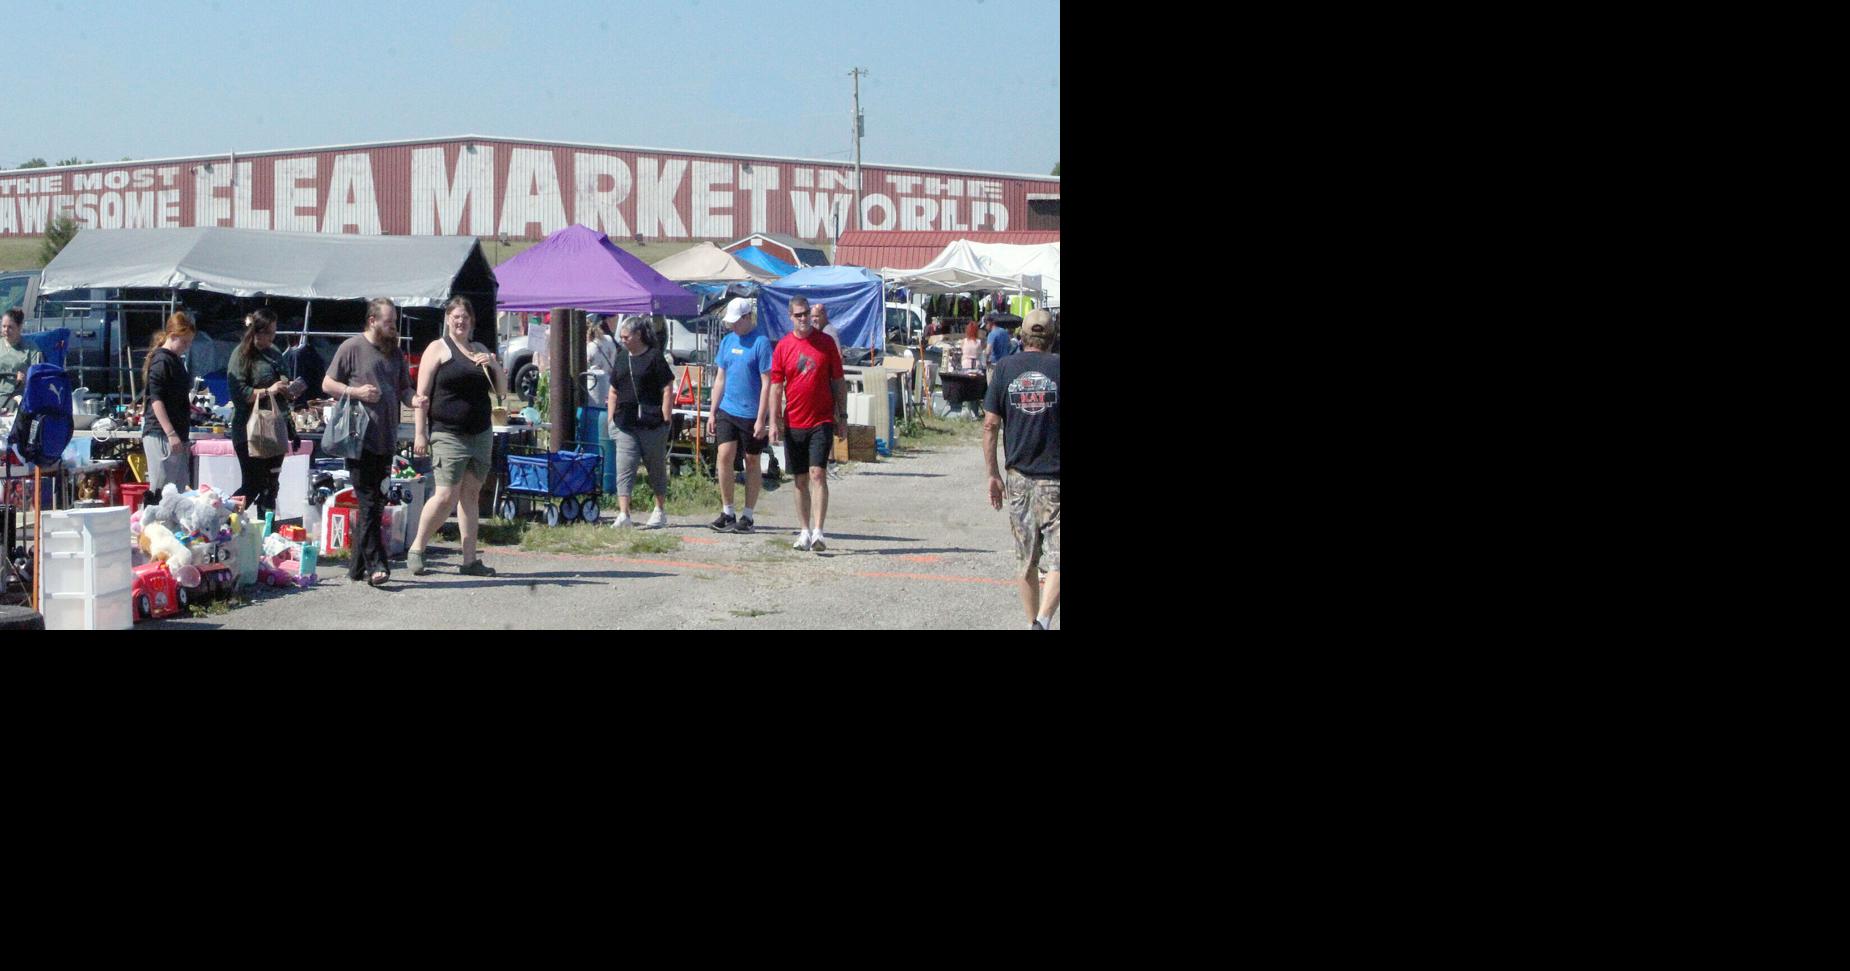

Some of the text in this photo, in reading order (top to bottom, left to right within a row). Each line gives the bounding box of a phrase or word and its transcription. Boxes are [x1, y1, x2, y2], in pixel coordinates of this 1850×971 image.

[0, 166, 181, 194] THE MOST
[194, 144, 779, 238] FLEA MARKET
[793, 167, 1003, 199] IN THE
[0, 188, 181, 234] AWESOME
[790, 190, 1010, 239] WORLD
